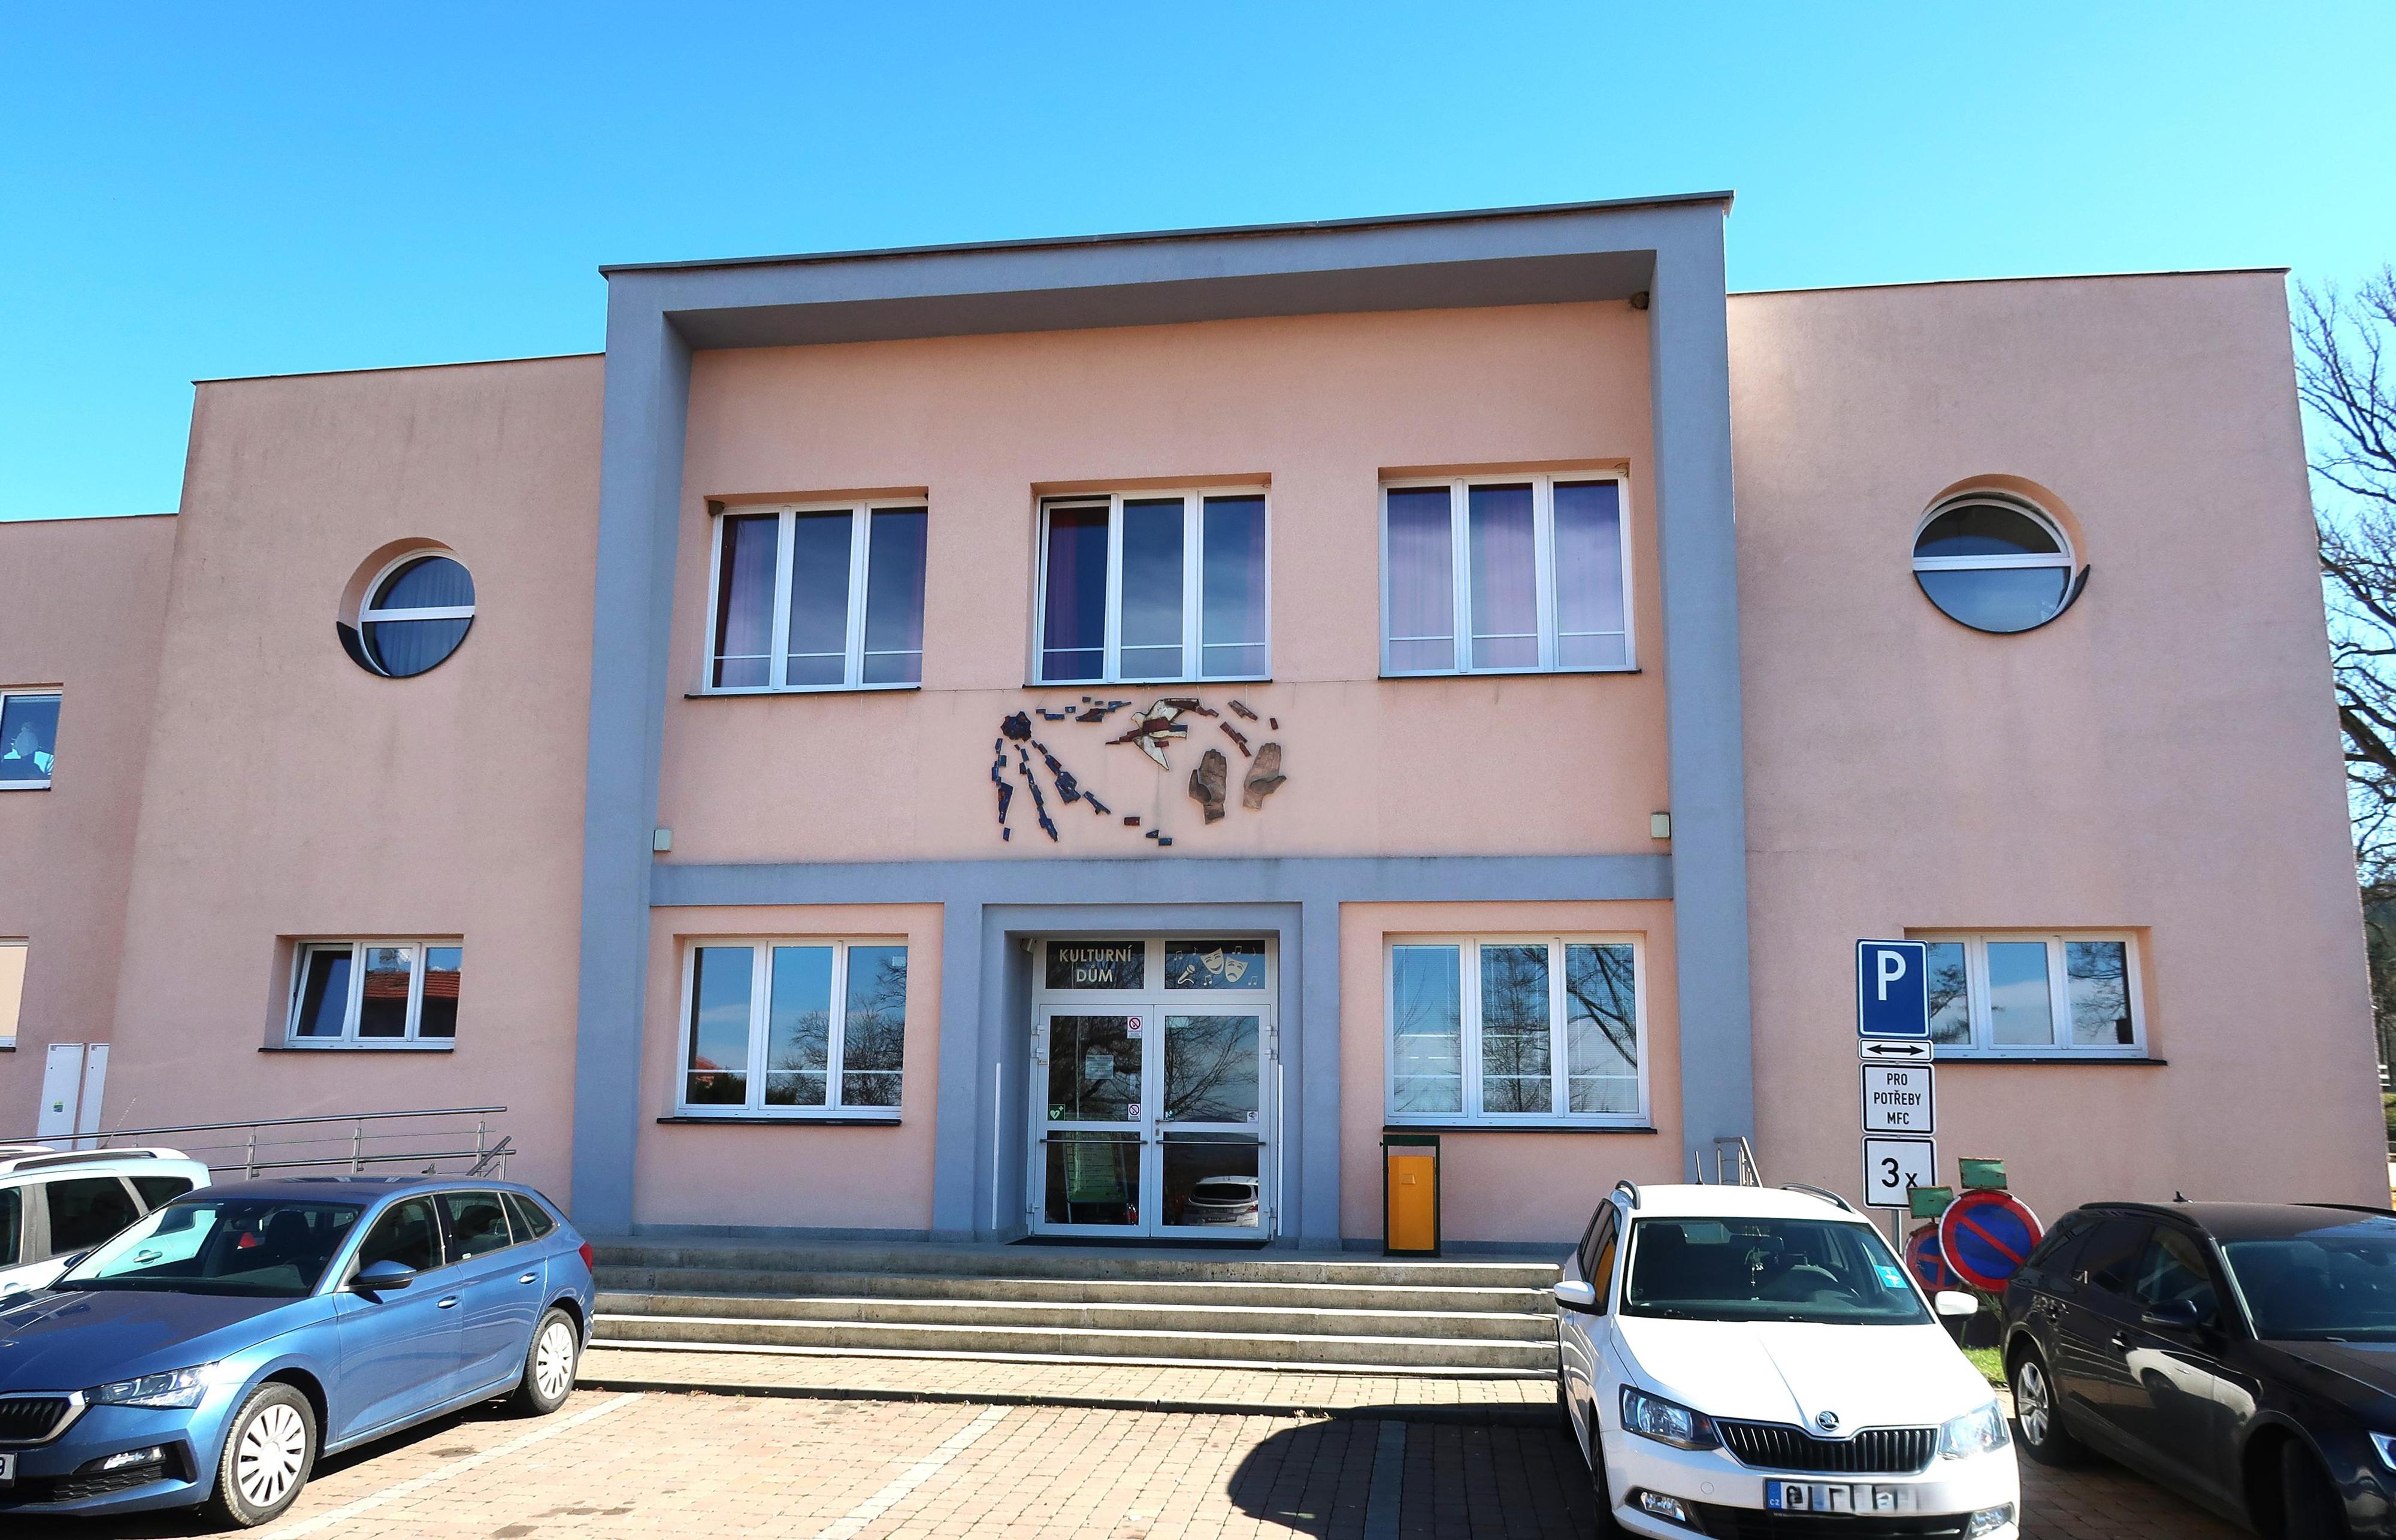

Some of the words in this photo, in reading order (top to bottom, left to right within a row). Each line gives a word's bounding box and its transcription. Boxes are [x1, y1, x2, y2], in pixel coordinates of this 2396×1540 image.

[1059, 945, 1132, 962] KULTURNÍ
[1076, 964, 1113, 982] DŮM
[1877, 950, 1906, 1001] P
[1887, 1073, 1908, 1086] PRO
[1874, 1090, 1921, 1106] POTŘEBY
[1887, 1112, 1909, 1125] MFC
